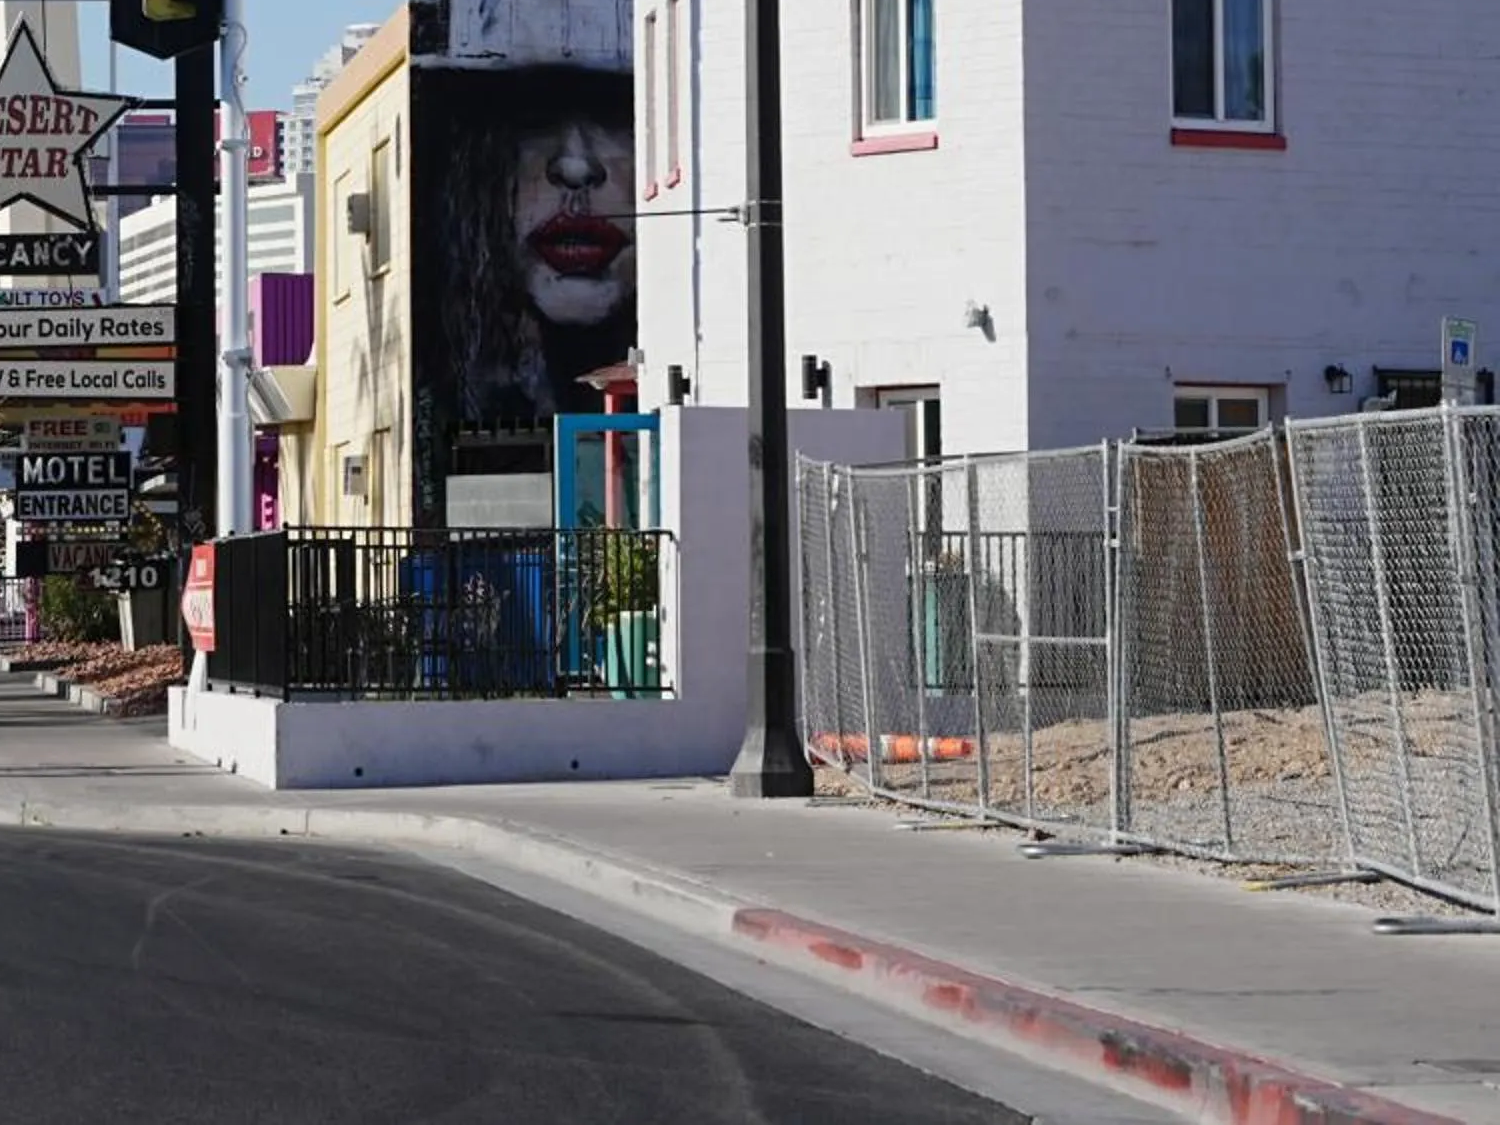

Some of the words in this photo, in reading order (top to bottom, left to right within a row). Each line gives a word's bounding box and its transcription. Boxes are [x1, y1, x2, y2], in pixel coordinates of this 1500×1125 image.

[38, 291, 85, 306] TOYS
[38, 317, 95, 342] Daily
[100, 318, 165, 337] Rates
[8, 368, 21, 388] &
[25, 368, 66, 388] Free
[71, 369, 118, 389] Local
[123, 368, 166, 389] Calls
[30, 420, 89, 436] FREE
[23, 455, 128, 485] MOTEL
[19, 493, 126, 517] ENTRANCE
[89, 567, 158, 589] 1210
